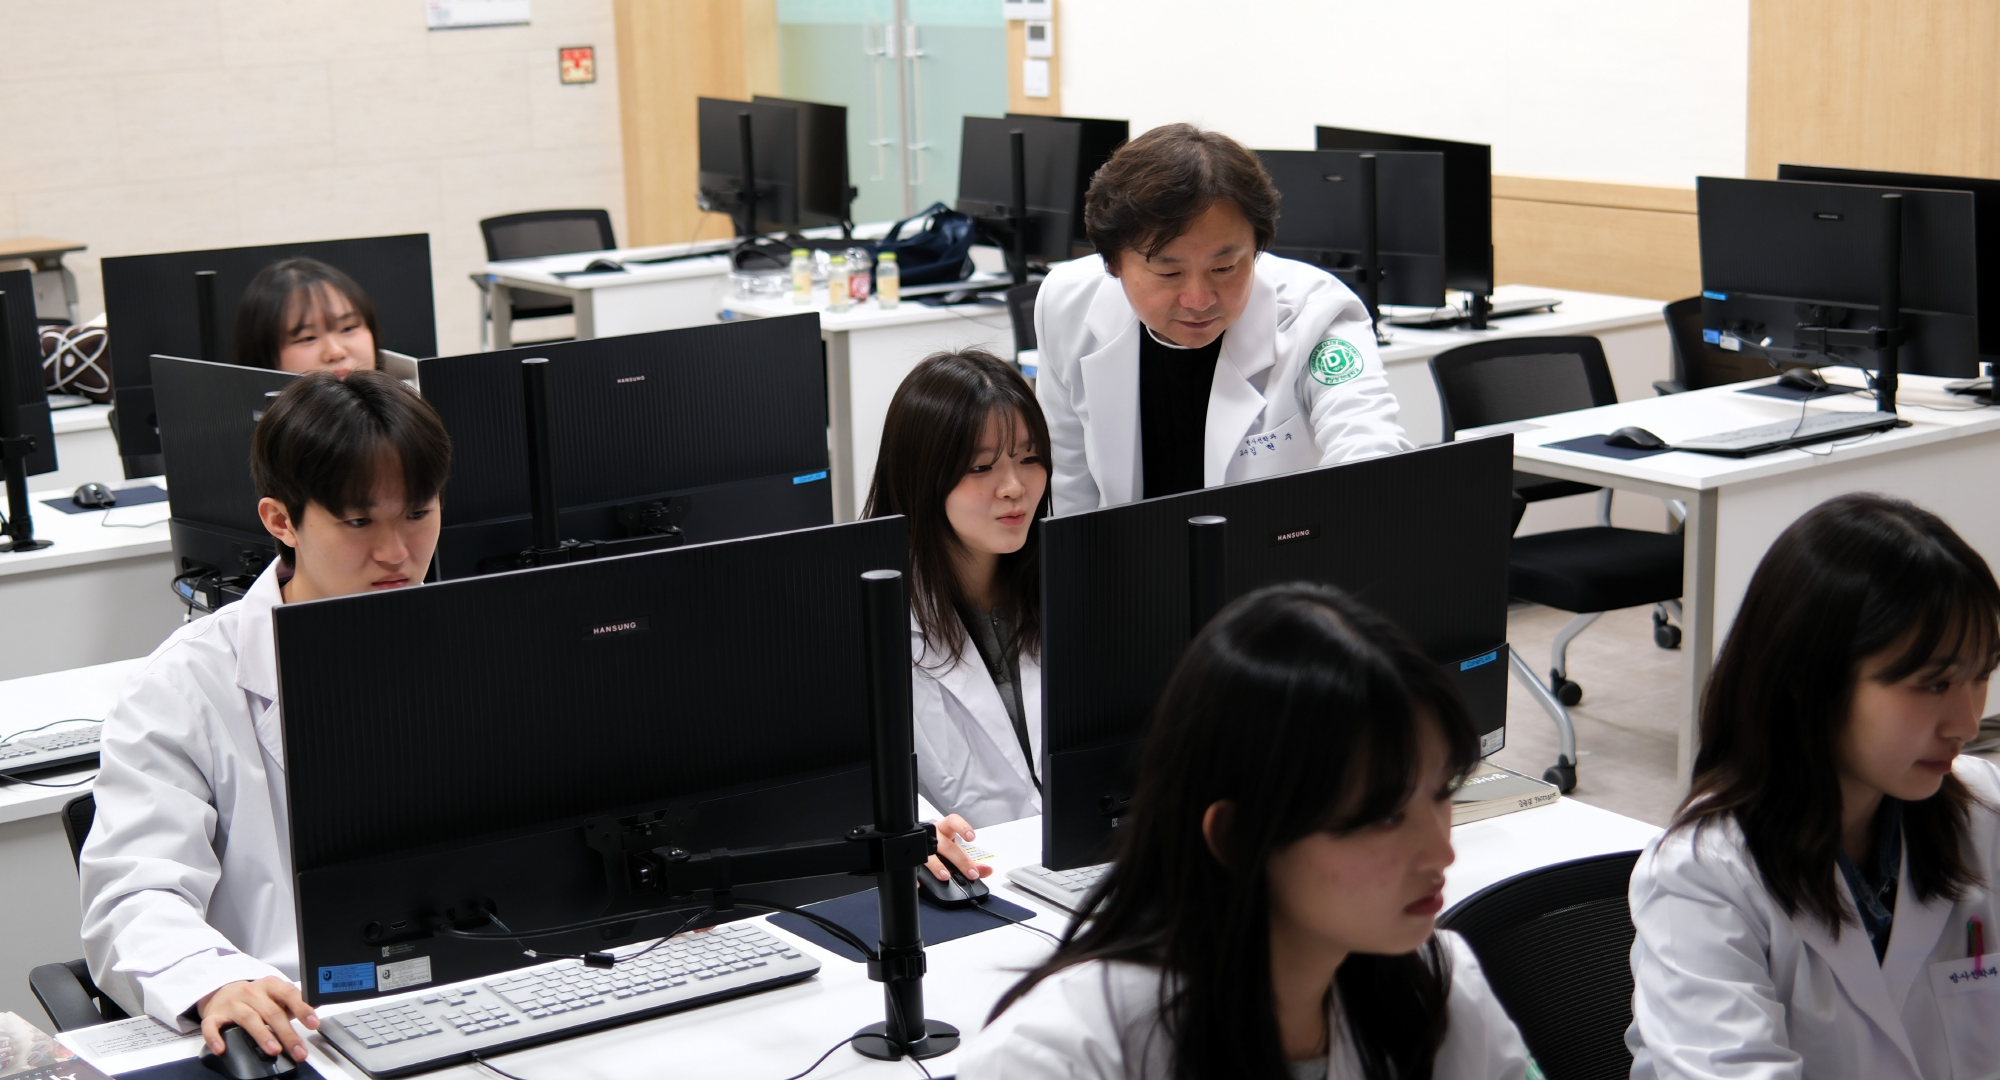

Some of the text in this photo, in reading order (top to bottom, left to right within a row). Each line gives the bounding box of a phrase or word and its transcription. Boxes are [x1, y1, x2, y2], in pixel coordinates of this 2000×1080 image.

[617, 375, 645, 383] HANSUNG
[1277, 529, 1310, 541] HANSUNG
[593, 621, 637, 635] HANSUNG
[1949, 966, 1998, 984] 방사선학과
